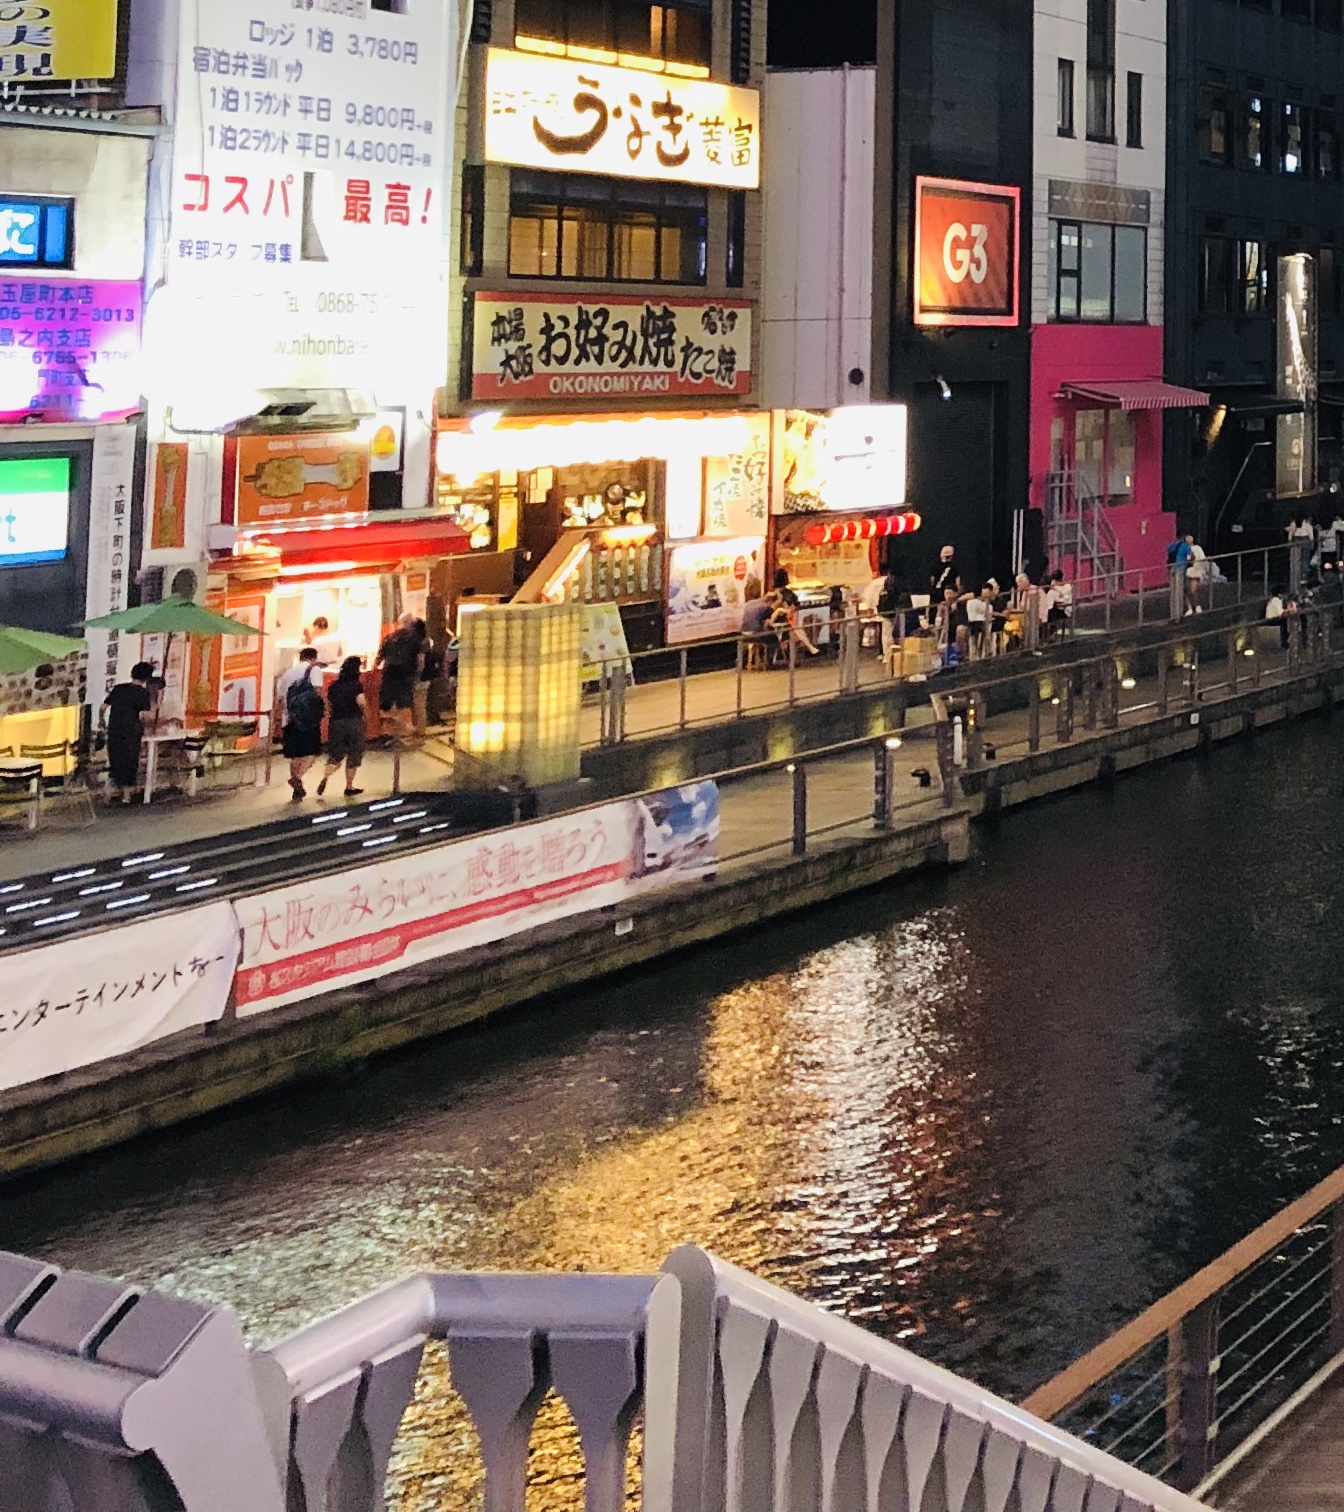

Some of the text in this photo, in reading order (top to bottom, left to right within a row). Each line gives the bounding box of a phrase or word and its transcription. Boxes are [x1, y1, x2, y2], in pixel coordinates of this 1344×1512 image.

[249, 19, 295, 46] ロッジ
[347, 33, 418, 65] 3,780円
[533, 75, 694, 168] うなぎ
[182, 173, 294, 218] コスパ
[178, 239, 293, 265] 幹部スタフ募集
[942, 222, 988, 284] G3
[538, 301, 678, 368] お好み焼
[549, 374, 670, 393] OKONOMIYAKI
